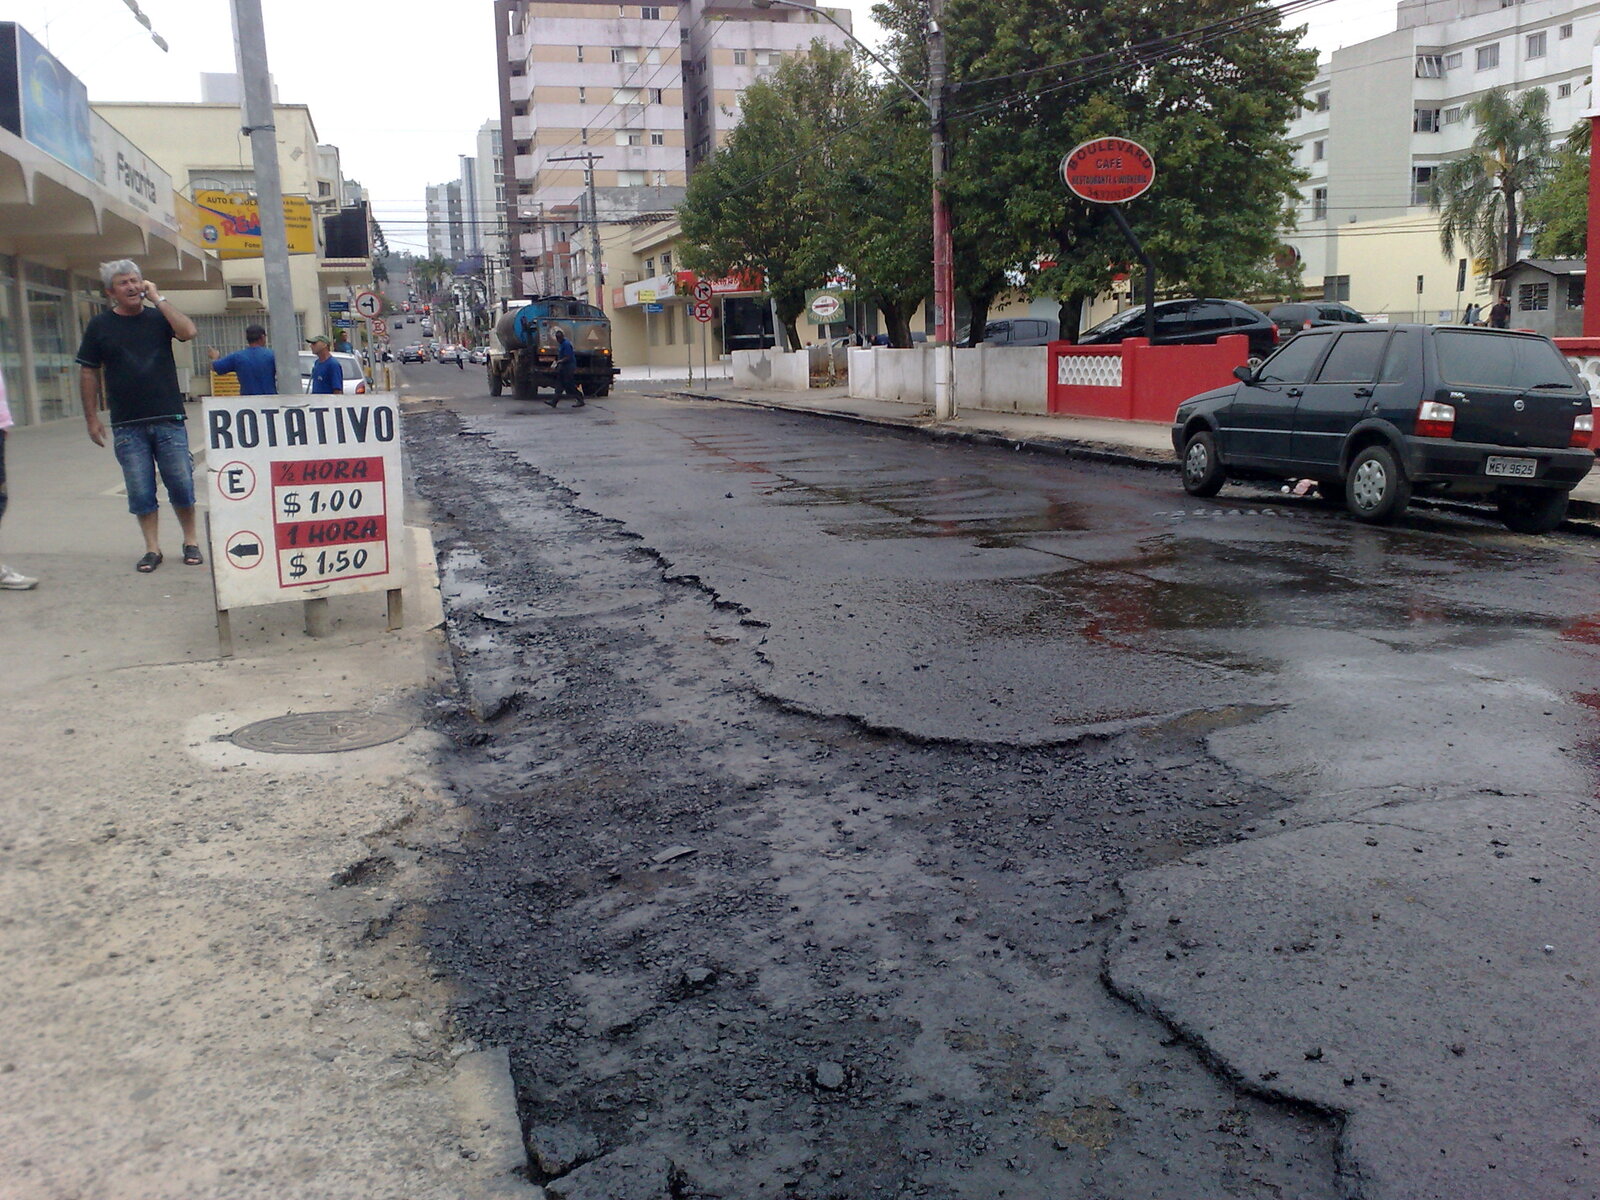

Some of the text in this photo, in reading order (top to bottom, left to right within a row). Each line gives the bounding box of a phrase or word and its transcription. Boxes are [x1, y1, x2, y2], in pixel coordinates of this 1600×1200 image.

[1068, 139, 1152, 170] BOULEVARD
[207, 196, 259, 206] AUTO ECOLA
[221, 212, 261, 236] REA
[208, 406, 394, 449] ROTATIVO
[228, 469, 245, 494] E
[302, 460, 368, 482] HORA
[308, 519, 378, 544] HORA
